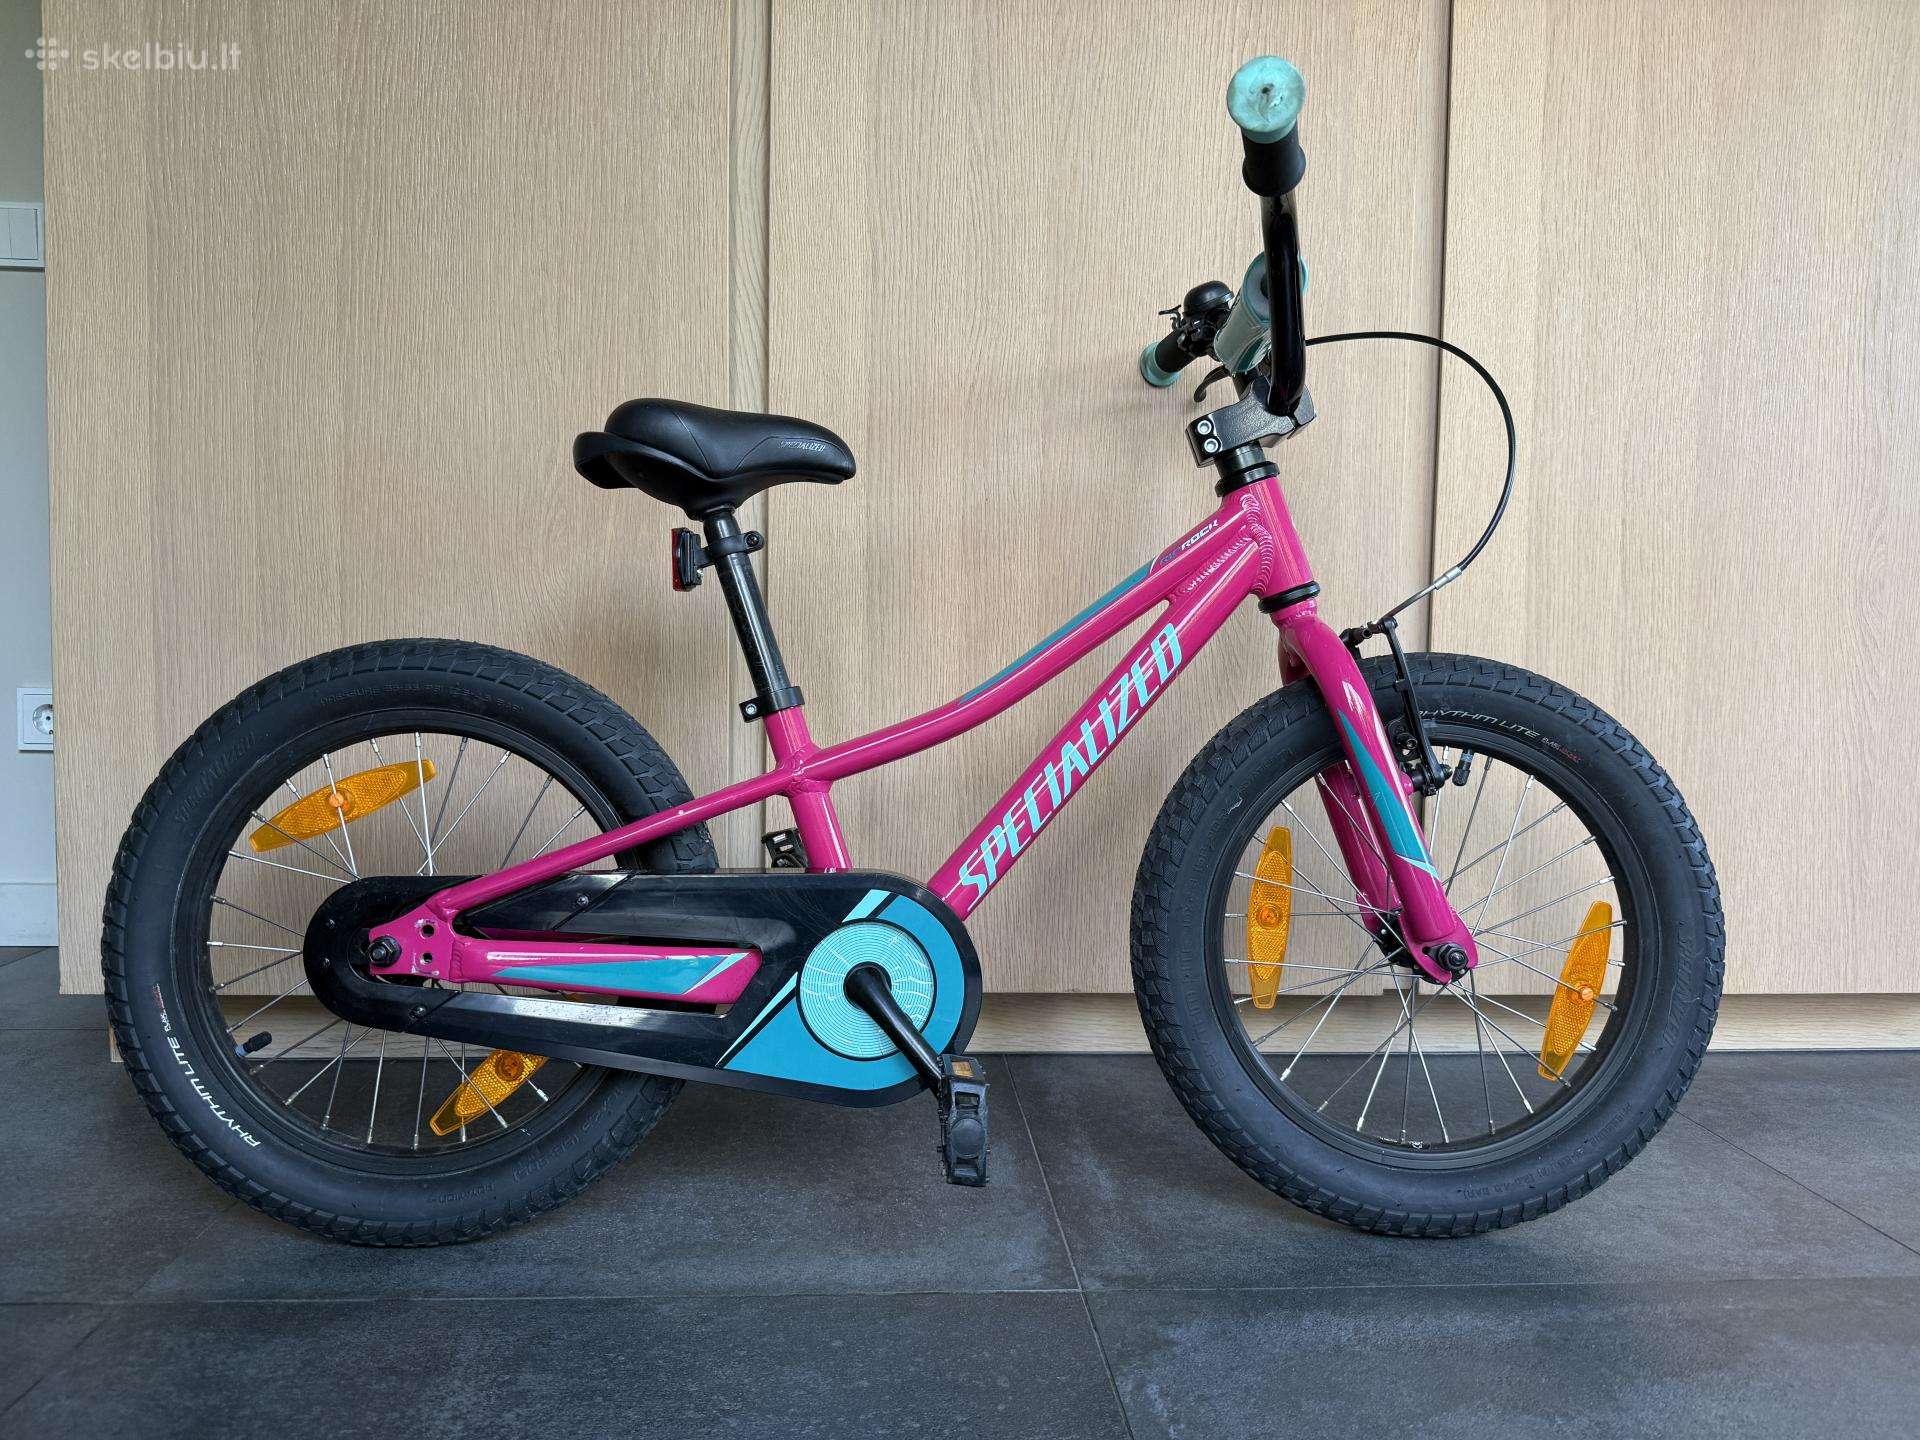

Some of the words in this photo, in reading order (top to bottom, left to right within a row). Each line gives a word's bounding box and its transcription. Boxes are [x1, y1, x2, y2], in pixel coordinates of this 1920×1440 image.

[1499, 721, 1541, 739] LITE
[957, 622, 1184, 913] SPECIALIZED
[167, 1036, 196, 1076] LITE
[190, 1078, 262, 1147] RHYTHM
